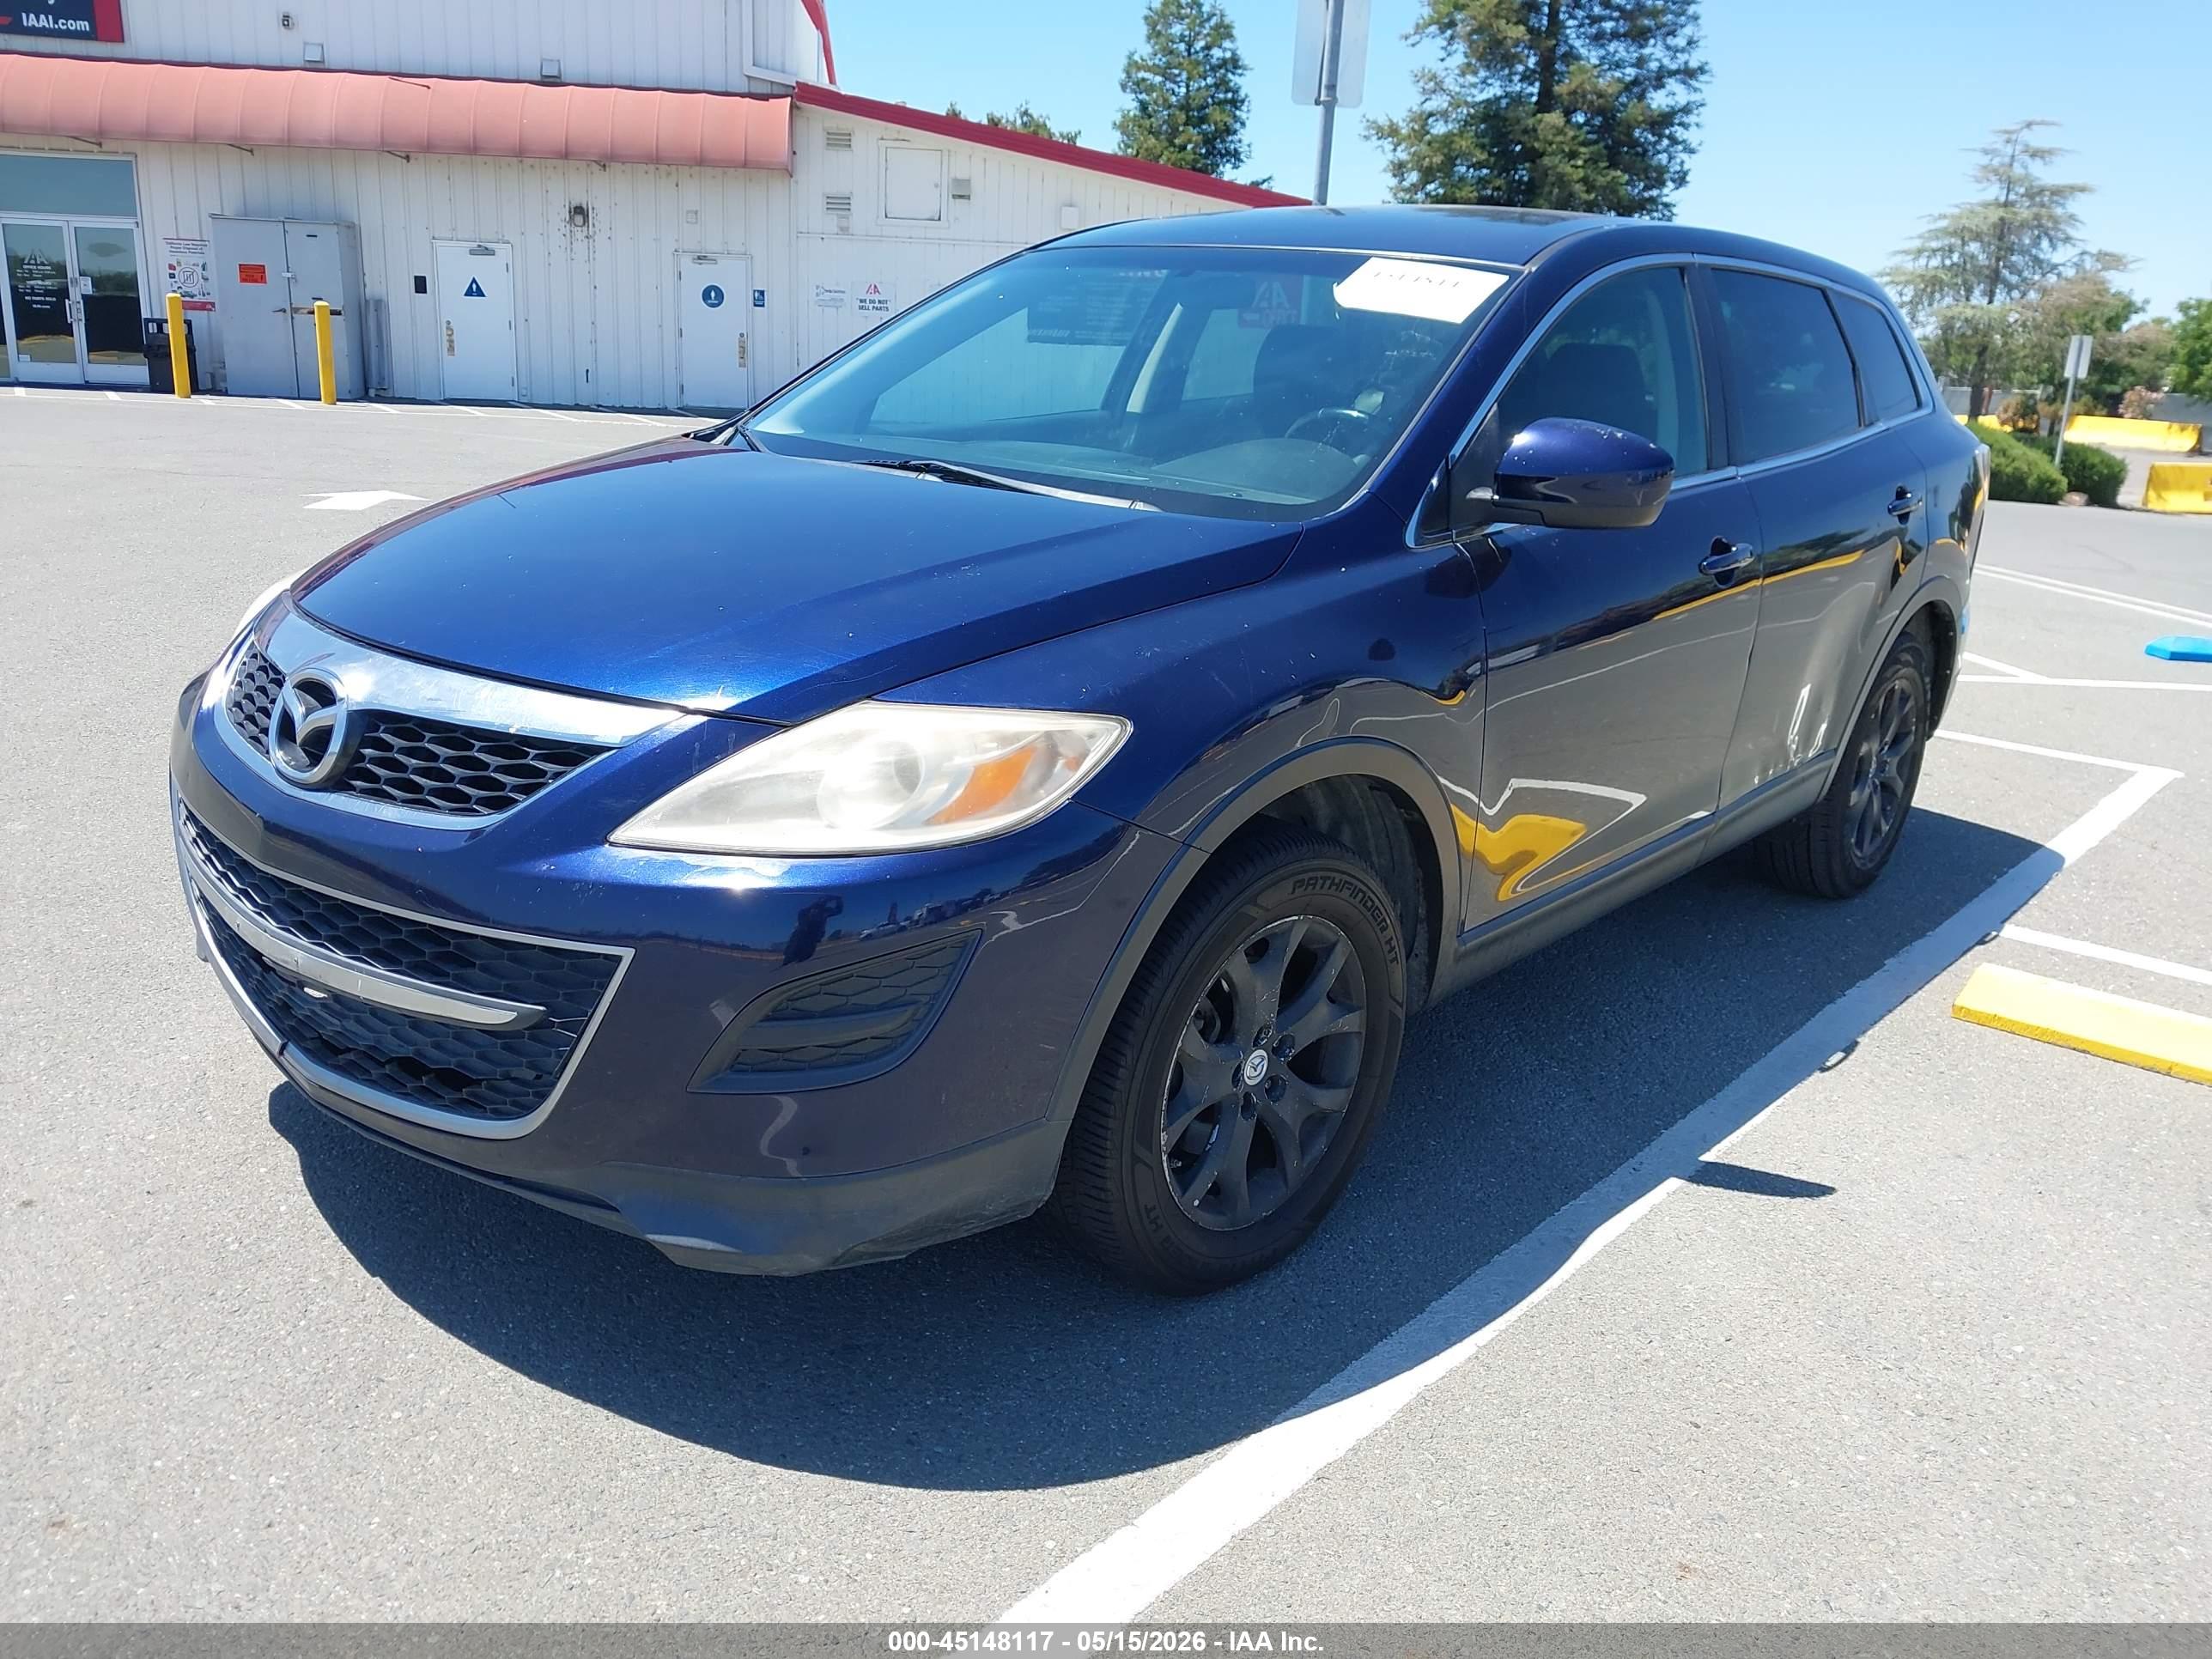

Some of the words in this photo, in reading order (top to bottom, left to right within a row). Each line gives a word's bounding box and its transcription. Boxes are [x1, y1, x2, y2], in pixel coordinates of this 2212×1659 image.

[21, 12, 90, 32] IAAI.com
[1291, 875, 1389, 934] PATHFINDER
[1383, 935, 1400, 966] HT
